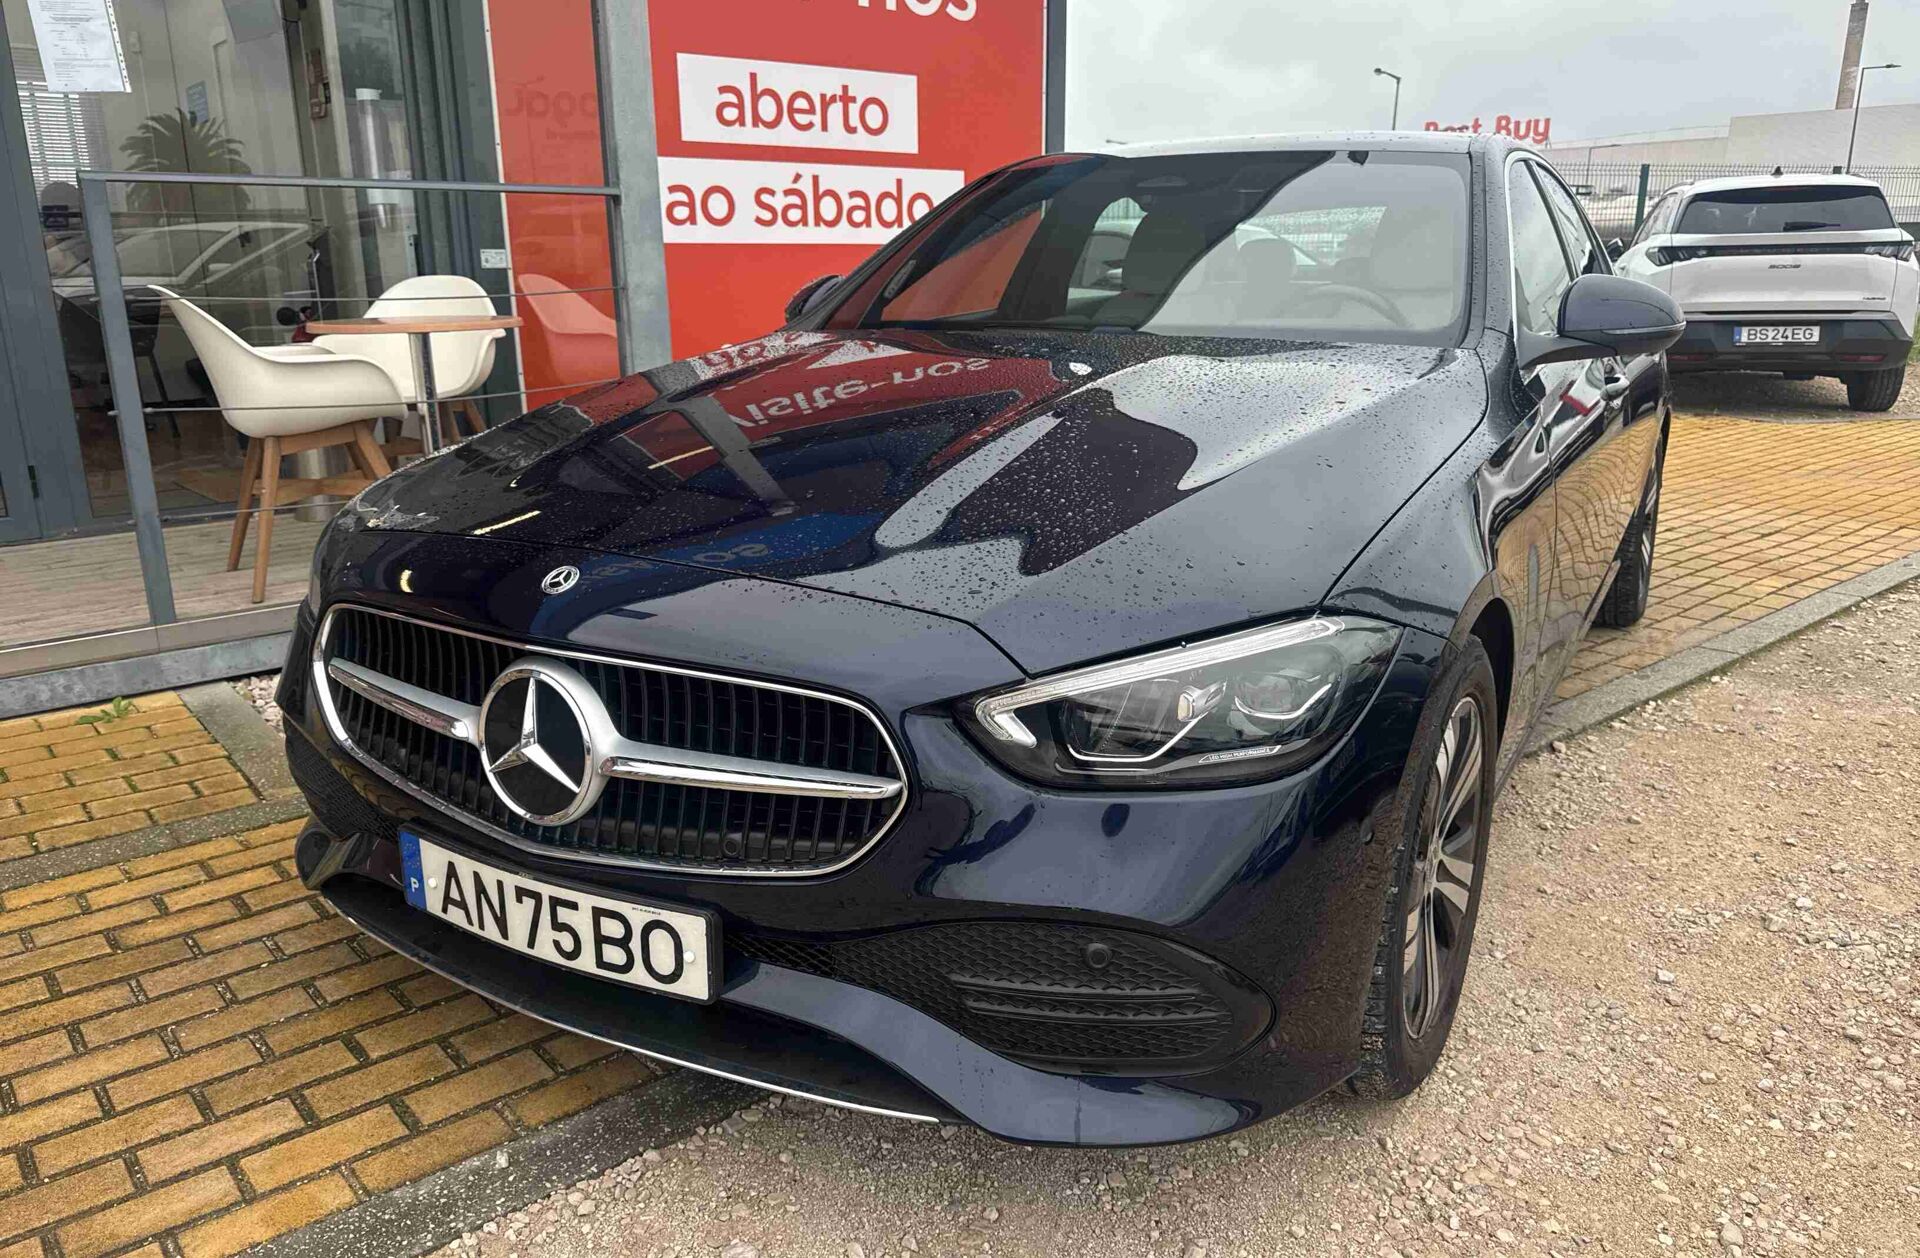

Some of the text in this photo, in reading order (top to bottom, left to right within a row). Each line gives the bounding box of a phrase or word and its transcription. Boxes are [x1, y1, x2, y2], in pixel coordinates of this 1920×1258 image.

[715, 72, 889, 136] aberto
[1495, 115, 1551, 144] Buy
[665, 172, 934, 229] ao sábado
[1747, 327, 1814, 341] BS24EG
[410, 877, 419, 892] P
[441, 860, 684, 985] AN75BO
